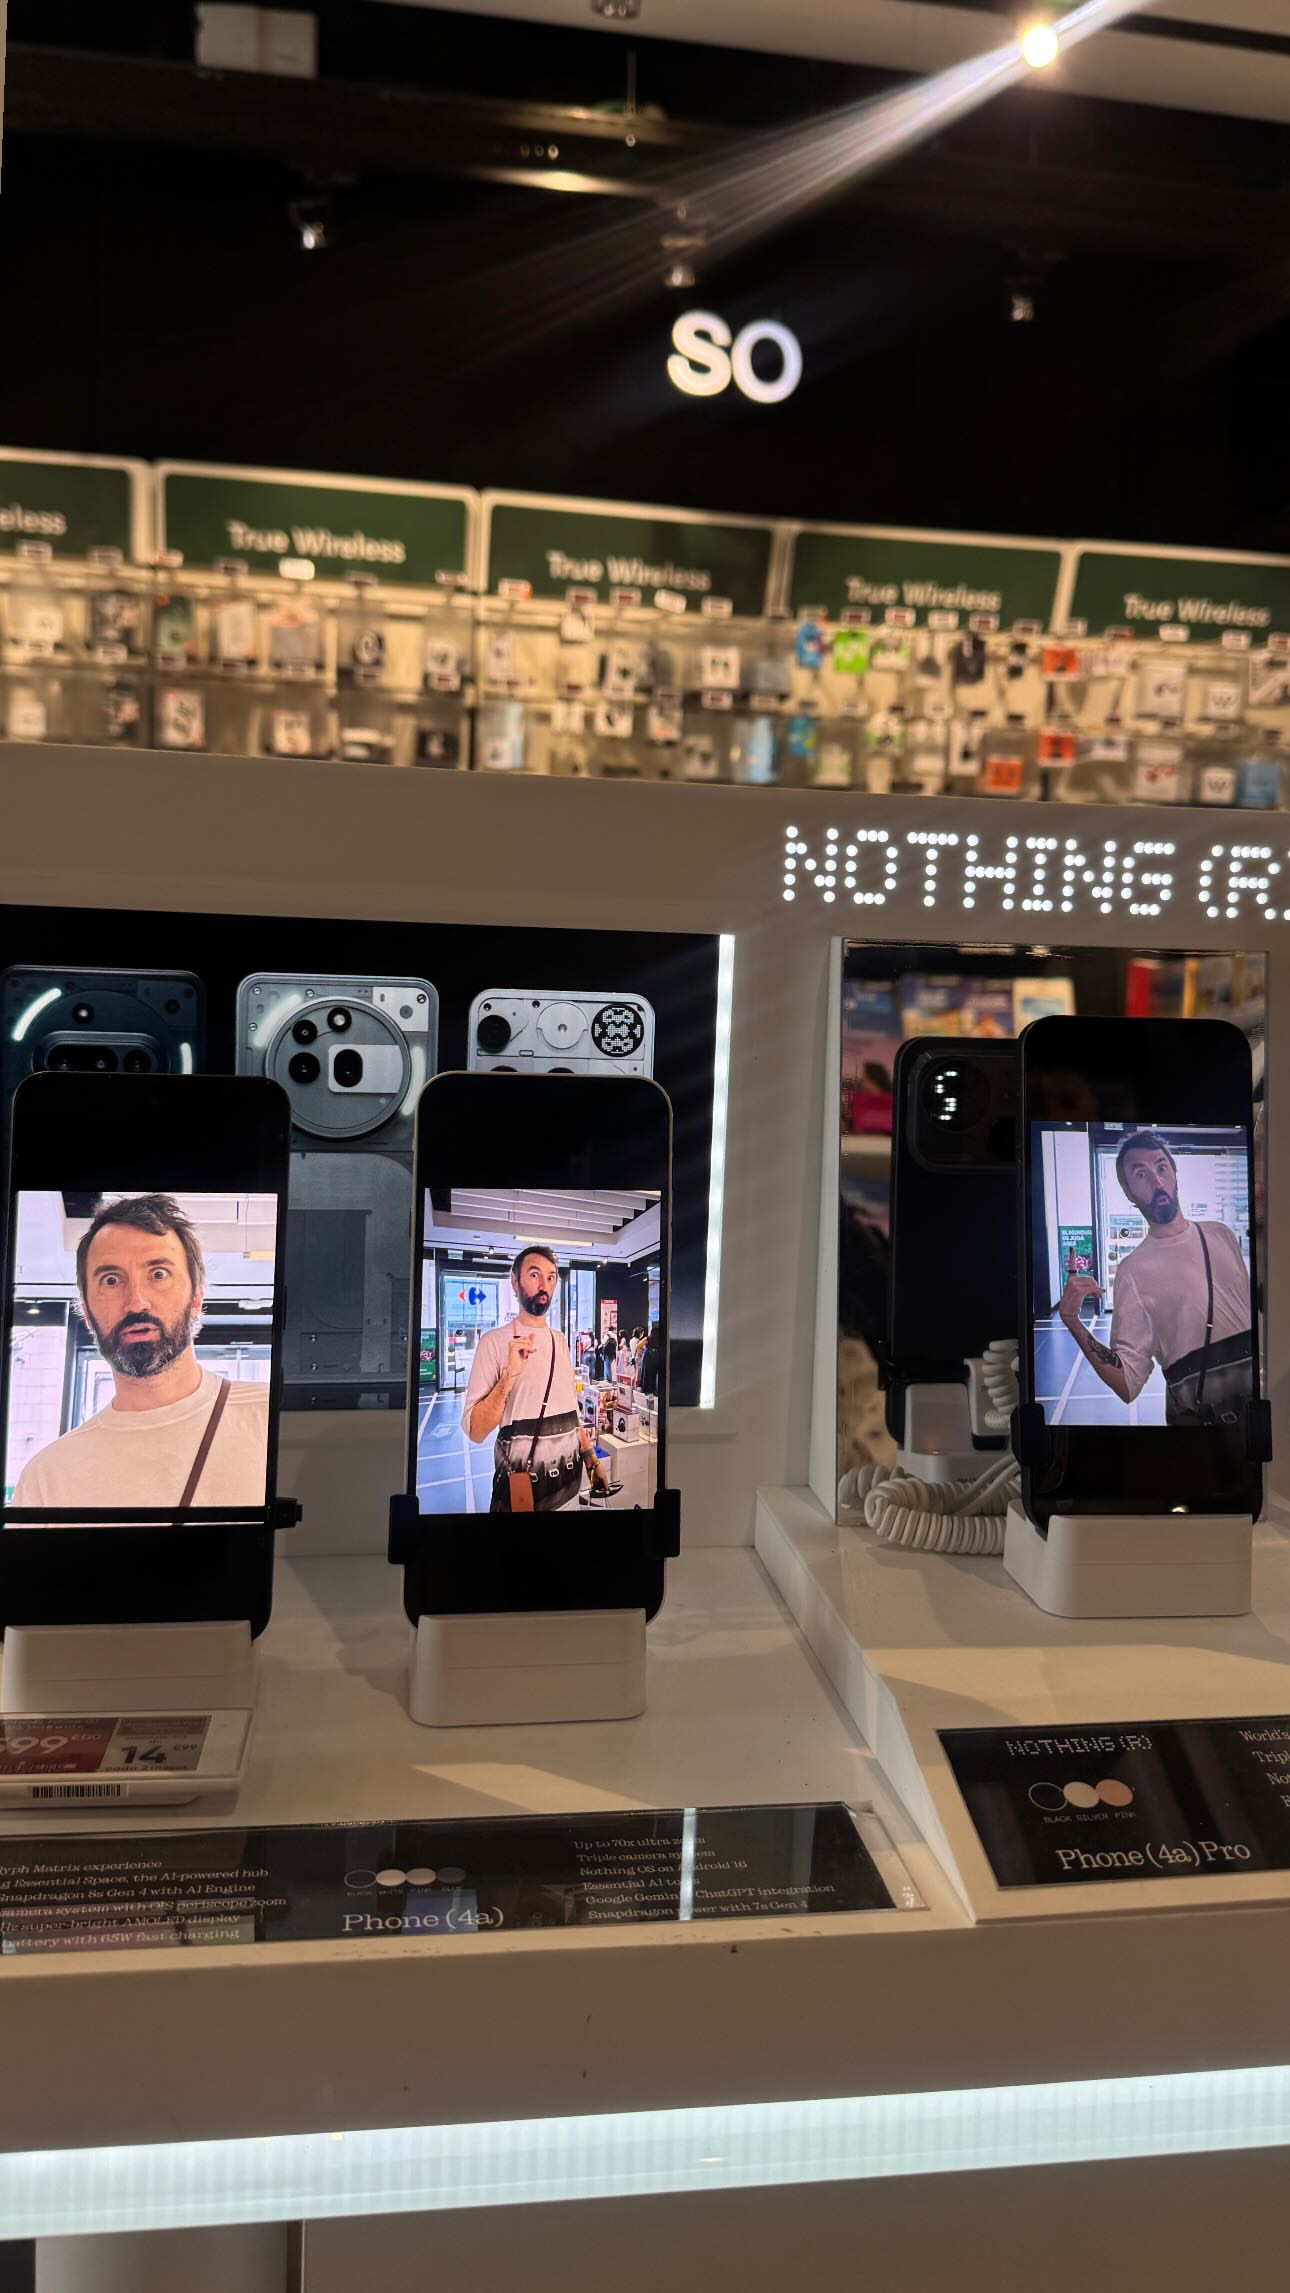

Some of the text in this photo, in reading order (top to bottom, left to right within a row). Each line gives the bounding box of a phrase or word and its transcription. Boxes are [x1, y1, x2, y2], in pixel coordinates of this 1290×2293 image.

[667, 309, 802, 403] SO
[226, 519, 406, 563] True Wireless
[546, 550, 711, 591] True Wireless
[846, 576, 1002, 612] True Wireless
[1123, 592, 1271, 627] True Wireless
[783, 825, 1175, 915] NOTHING
[1239, 1729, 1290, 1741] World's
[121, 1744, 168, 1764] 14
[1005, 1735, 1153, 1756] NOTHING (R)
[1043, 1811, 1136, 1823] BLACK SILVER PINK
[574, 1837, 705, 1850] Up to 70x ultra zm
[576, 1850, 715, 1863] Triple camera syem
[1055, 1840, 1251, 1870] Phone (4a) Pro
[33, 1863, 80, 1873] Matrix
[83, 1861, 162, 1872] experience
[580, 1866, 637, 1877] Nothing
[637, 1865, 656, 1873] OS
[657, 1865, 674, 1873] on
[678, 1860, 731, 1872] droid
[14, 1876, 80, 1888] Essential
[133, 1873, 158, 1882] the
[161, 1868, 239, 1882] AI-powered
[242, 1867, 269, 1877] hub
[583, 1880, 645, 1890] Essential
[649, 1878, 665, 1888] AI
[106, 1887, 135, 1897] Gen
[138, 1887, 147, 1896] 4
[151, 1885, 182, 1895] with
[186, 1884, 202, 1895] AI
[205, 1883, 256, 1895] Engine
[585, 1884, 836, 1905] Google Gemin ChatGPT integration
[55, 1905, 109, 1916] system
[112, 1903, 146, 1912] with
[251, 1898, 287, 1907] zoom
[588, 1907, 674, 1920] Snapdragon
[719, 1902, 751, 1912] with
[768, 1900, 798, 1910] Gen
[19, 1919, 119, 1932] super-bright
[122, 1915, 185, 1927] AMOLED
[187, 1913, 240, 1925] display
[341, 1905, 504, 1932] Phone (4a)
[63, 1935, 97, 1945] with
[136, 1931, 171, 1941] fast
[171, 1930, 240, 1942] charging
